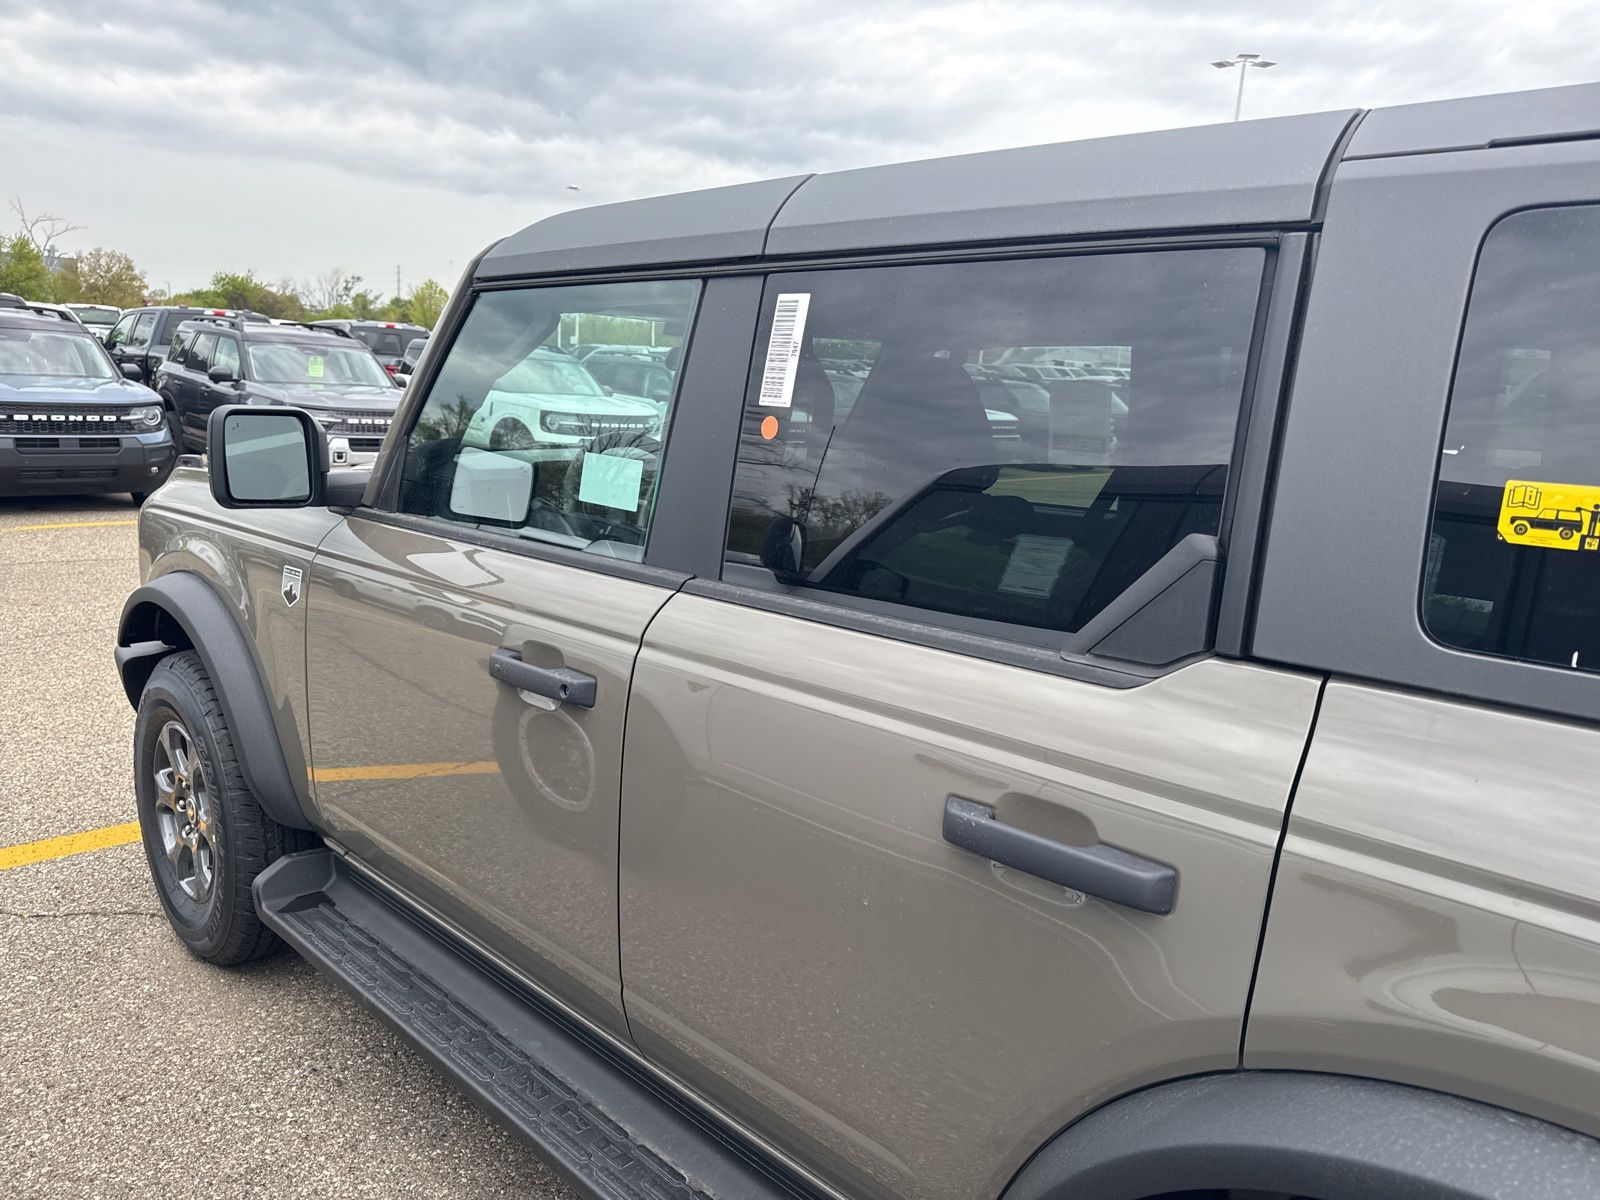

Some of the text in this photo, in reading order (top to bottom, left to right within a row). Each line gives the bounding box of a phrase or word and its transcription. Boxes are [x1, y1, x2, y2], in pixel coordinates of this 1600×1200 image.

[791, 341, 799, 357] 7947
[13, 414, 117, 422] BRONCO
[413, 1000, 635, 1169] BRONCO
